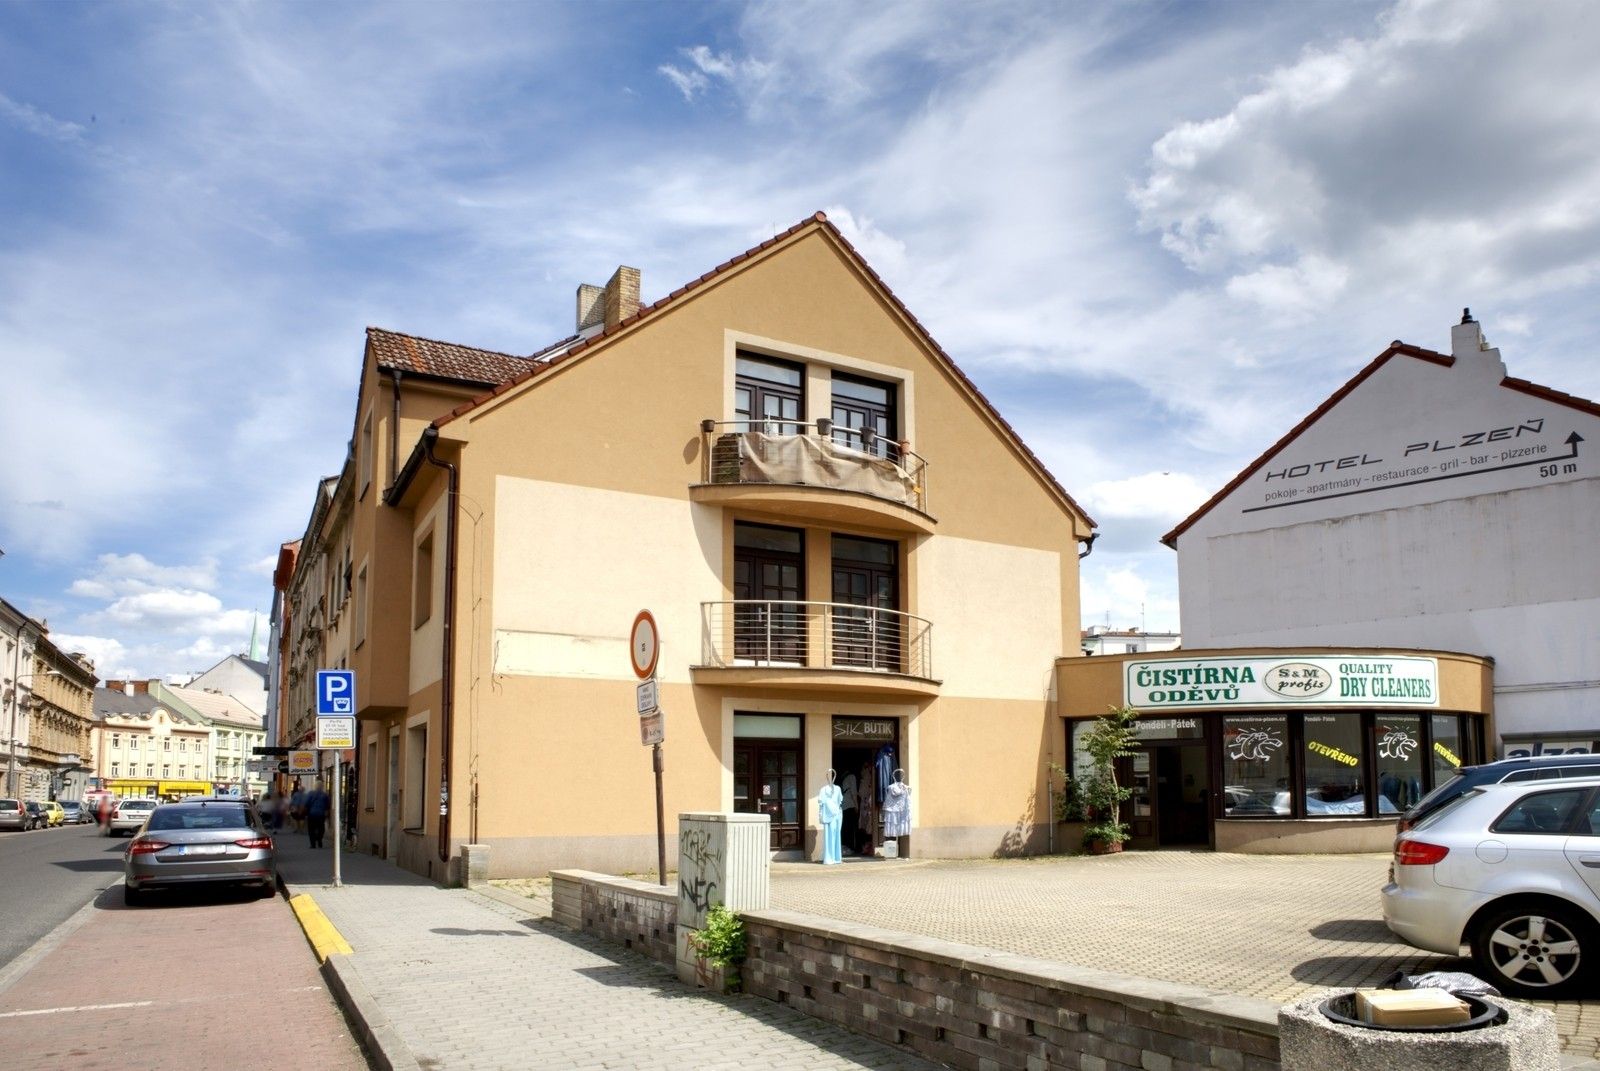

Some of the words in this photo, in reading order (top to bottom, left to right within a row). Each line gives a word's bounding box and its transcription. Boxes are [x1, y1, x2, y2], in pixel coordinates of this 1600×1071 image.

[1265, 454, 1383, 482] HOTEL
[1404, 418, 1544, 457] PLZEŇ
[1265, 488, 1298, 502] pokoje
[1306, 477, 1362, 494] apartmány
[1372, 463, 1429, 482] restaurace
[1440, 459, 1459, 473] gril
[1470, 454, 1488, 466] bar
[1501, 444, 1547, 461] pizzerie
[1540, 463, 1557, 478] 50
[1564, 463, 1577, 473] m
[1136, 663, 1256, 687] ČISTÍRNA
[1278, 669, 1290, 678] S
[1292, 670, 1300, 678] &
[1302, 669, 1319, 678] M
[1339, 663, 1393, 675] QUALITY
[326, 675, 348, 701] P
[1149, 684, 1240, 702] ODĚVŮ
[1278, 678, 1324, 692] profis
[1340, 677, 1368, 697] DRY
[1372, 677, 1431, 698] CLEANERS
[864, 721, 892, 734] BUTIK
[1308, 741, 1358, 767] OTEVŘENO
